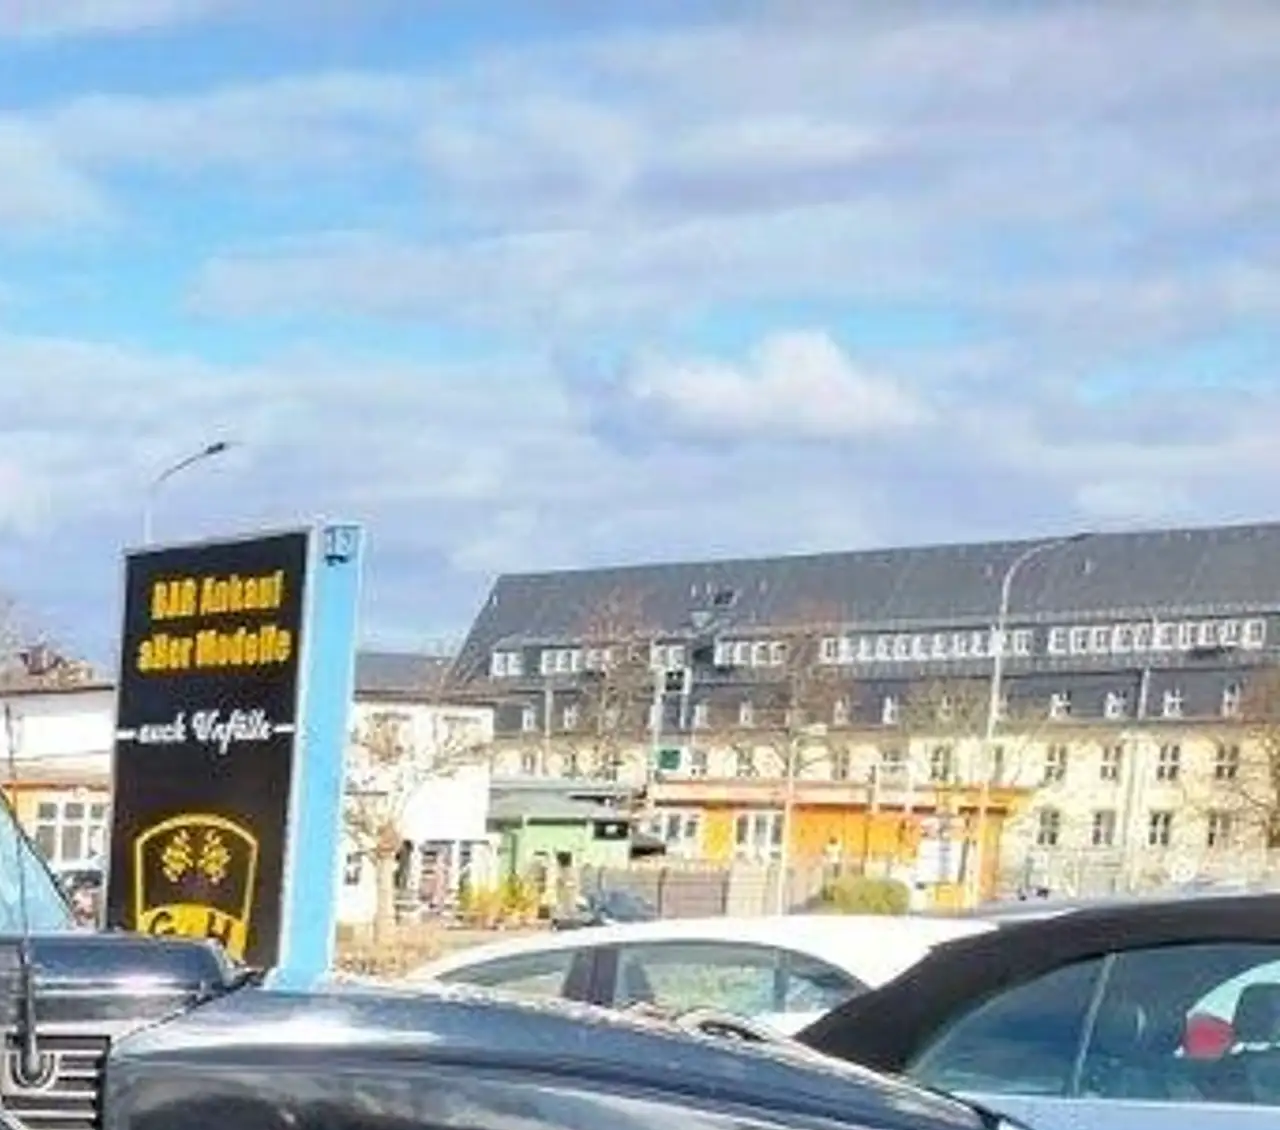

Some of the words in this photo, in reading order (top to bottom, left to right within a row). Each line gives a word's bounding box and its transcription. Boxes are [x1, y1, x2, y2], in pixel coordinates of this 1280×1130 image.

[200, 569, 285, 616] Ankauf
[137, 633, 194, 674] aller
[196, 624, 292, 669] Modelle
[138, 711, 187, 744] auch
